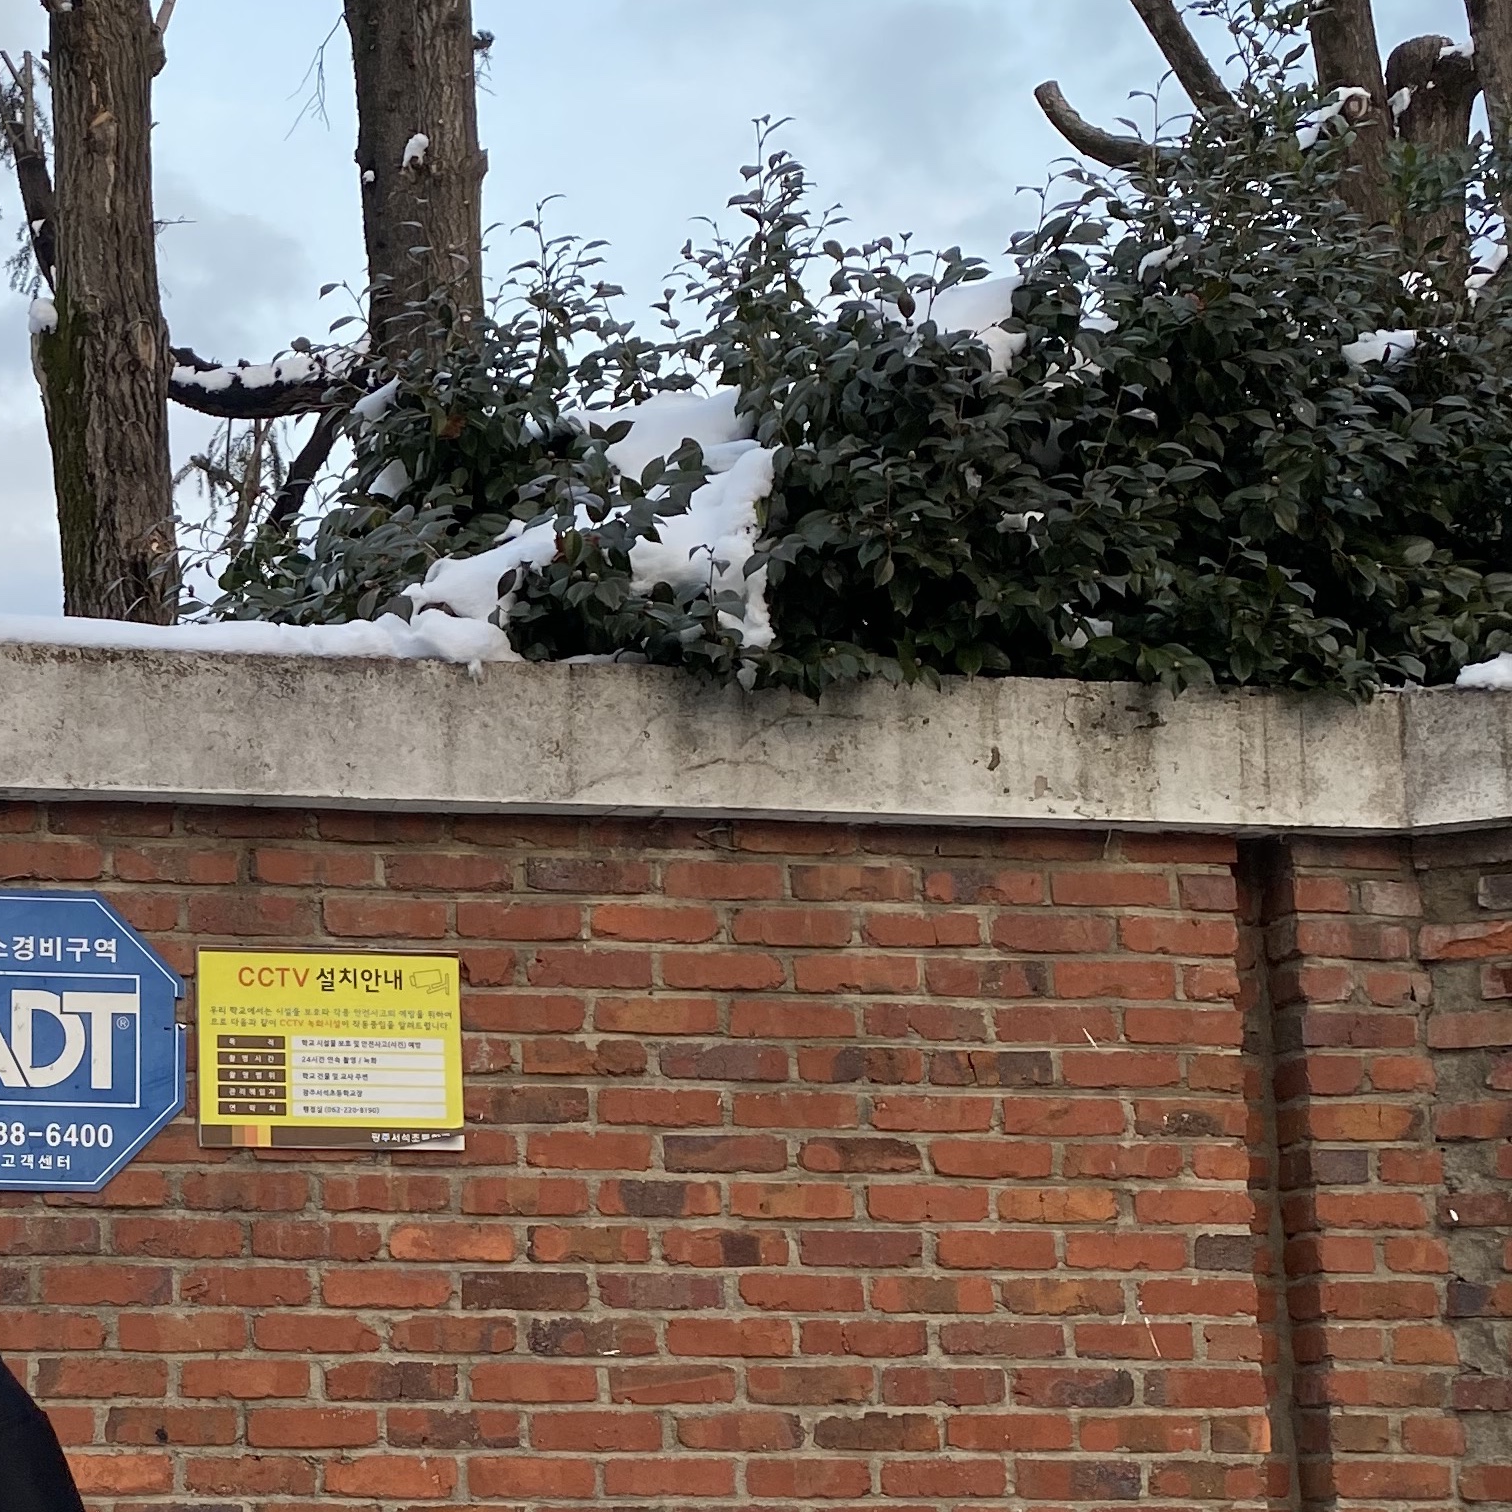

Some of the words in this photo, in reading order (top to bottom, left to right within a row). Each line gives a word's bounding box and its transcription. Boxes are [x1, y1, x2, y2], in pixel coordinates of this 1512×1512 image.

[238, 966, 311, 988] CCTV
[316, 967, 404, 993] 설치안내
[210, 1005, 227, 1015] 우리
[279, 1018, 305, 1027] CCTV
[0, 1154, 72, 1171] 고객센터
